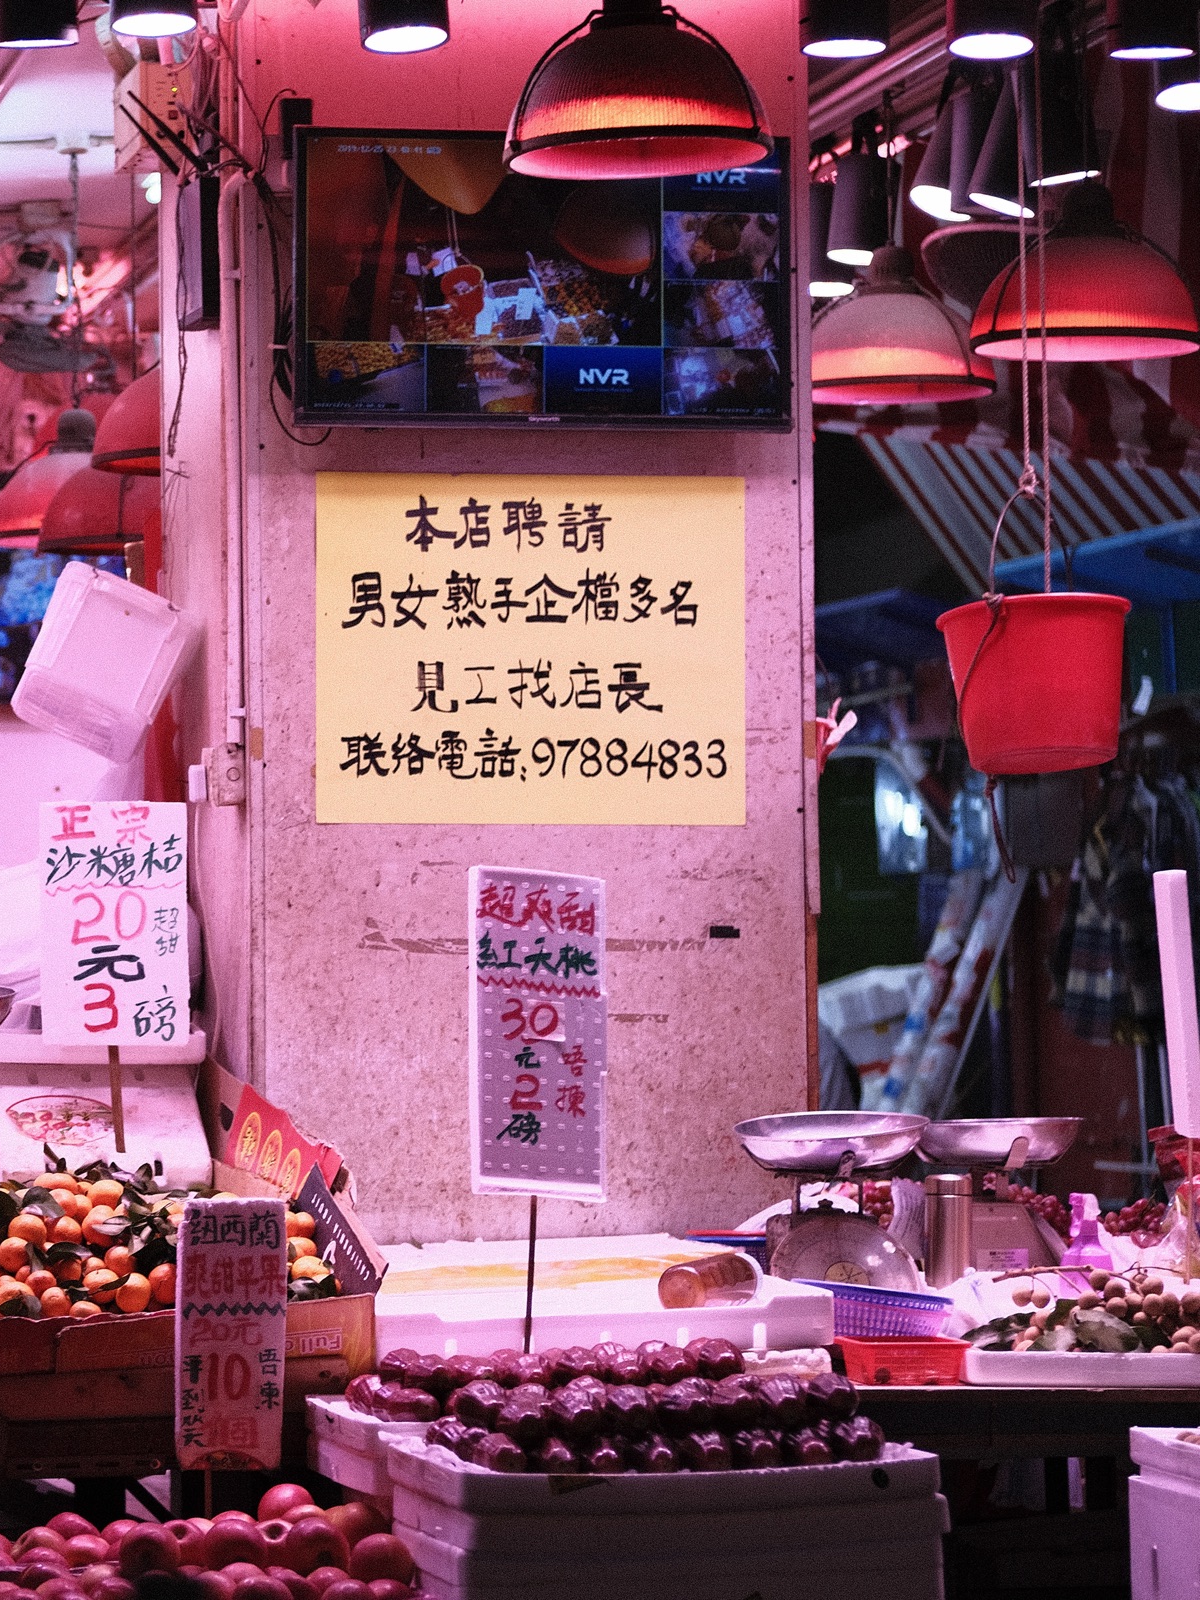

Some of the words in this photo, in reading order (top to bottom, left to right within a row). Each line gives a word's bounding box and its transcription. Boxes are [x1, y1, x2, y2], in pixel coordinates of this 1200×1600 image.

[578, 368, 630, 386] NVR
[405, 495, 612, 553] 本店聘請
[341, 567, 699, 630] 男女熟手企檔多名
[411, 658, 663, 714] 見工找店長
[51, 803, 152, 845] 正宗
[45, 833, 183, 887] 沙糖桔
[71, 891, 147, 945] 20
[476, 883, 596, 937] 超爽甜
[73, 944, 146, 982] 元
[83, 983, 119, 1033] 3
[133, 985, 177, 1043] 磅
[500, 998, 560, 1042] 30
[514, 1046, 542, 1070] 元
[509, 1073, 543, 1112] 2
[190, 1209, 281, 1250] 紐西蘭
[300, 1332, 342, 1355] Full
[207, 1352, 251, 1401] 10
